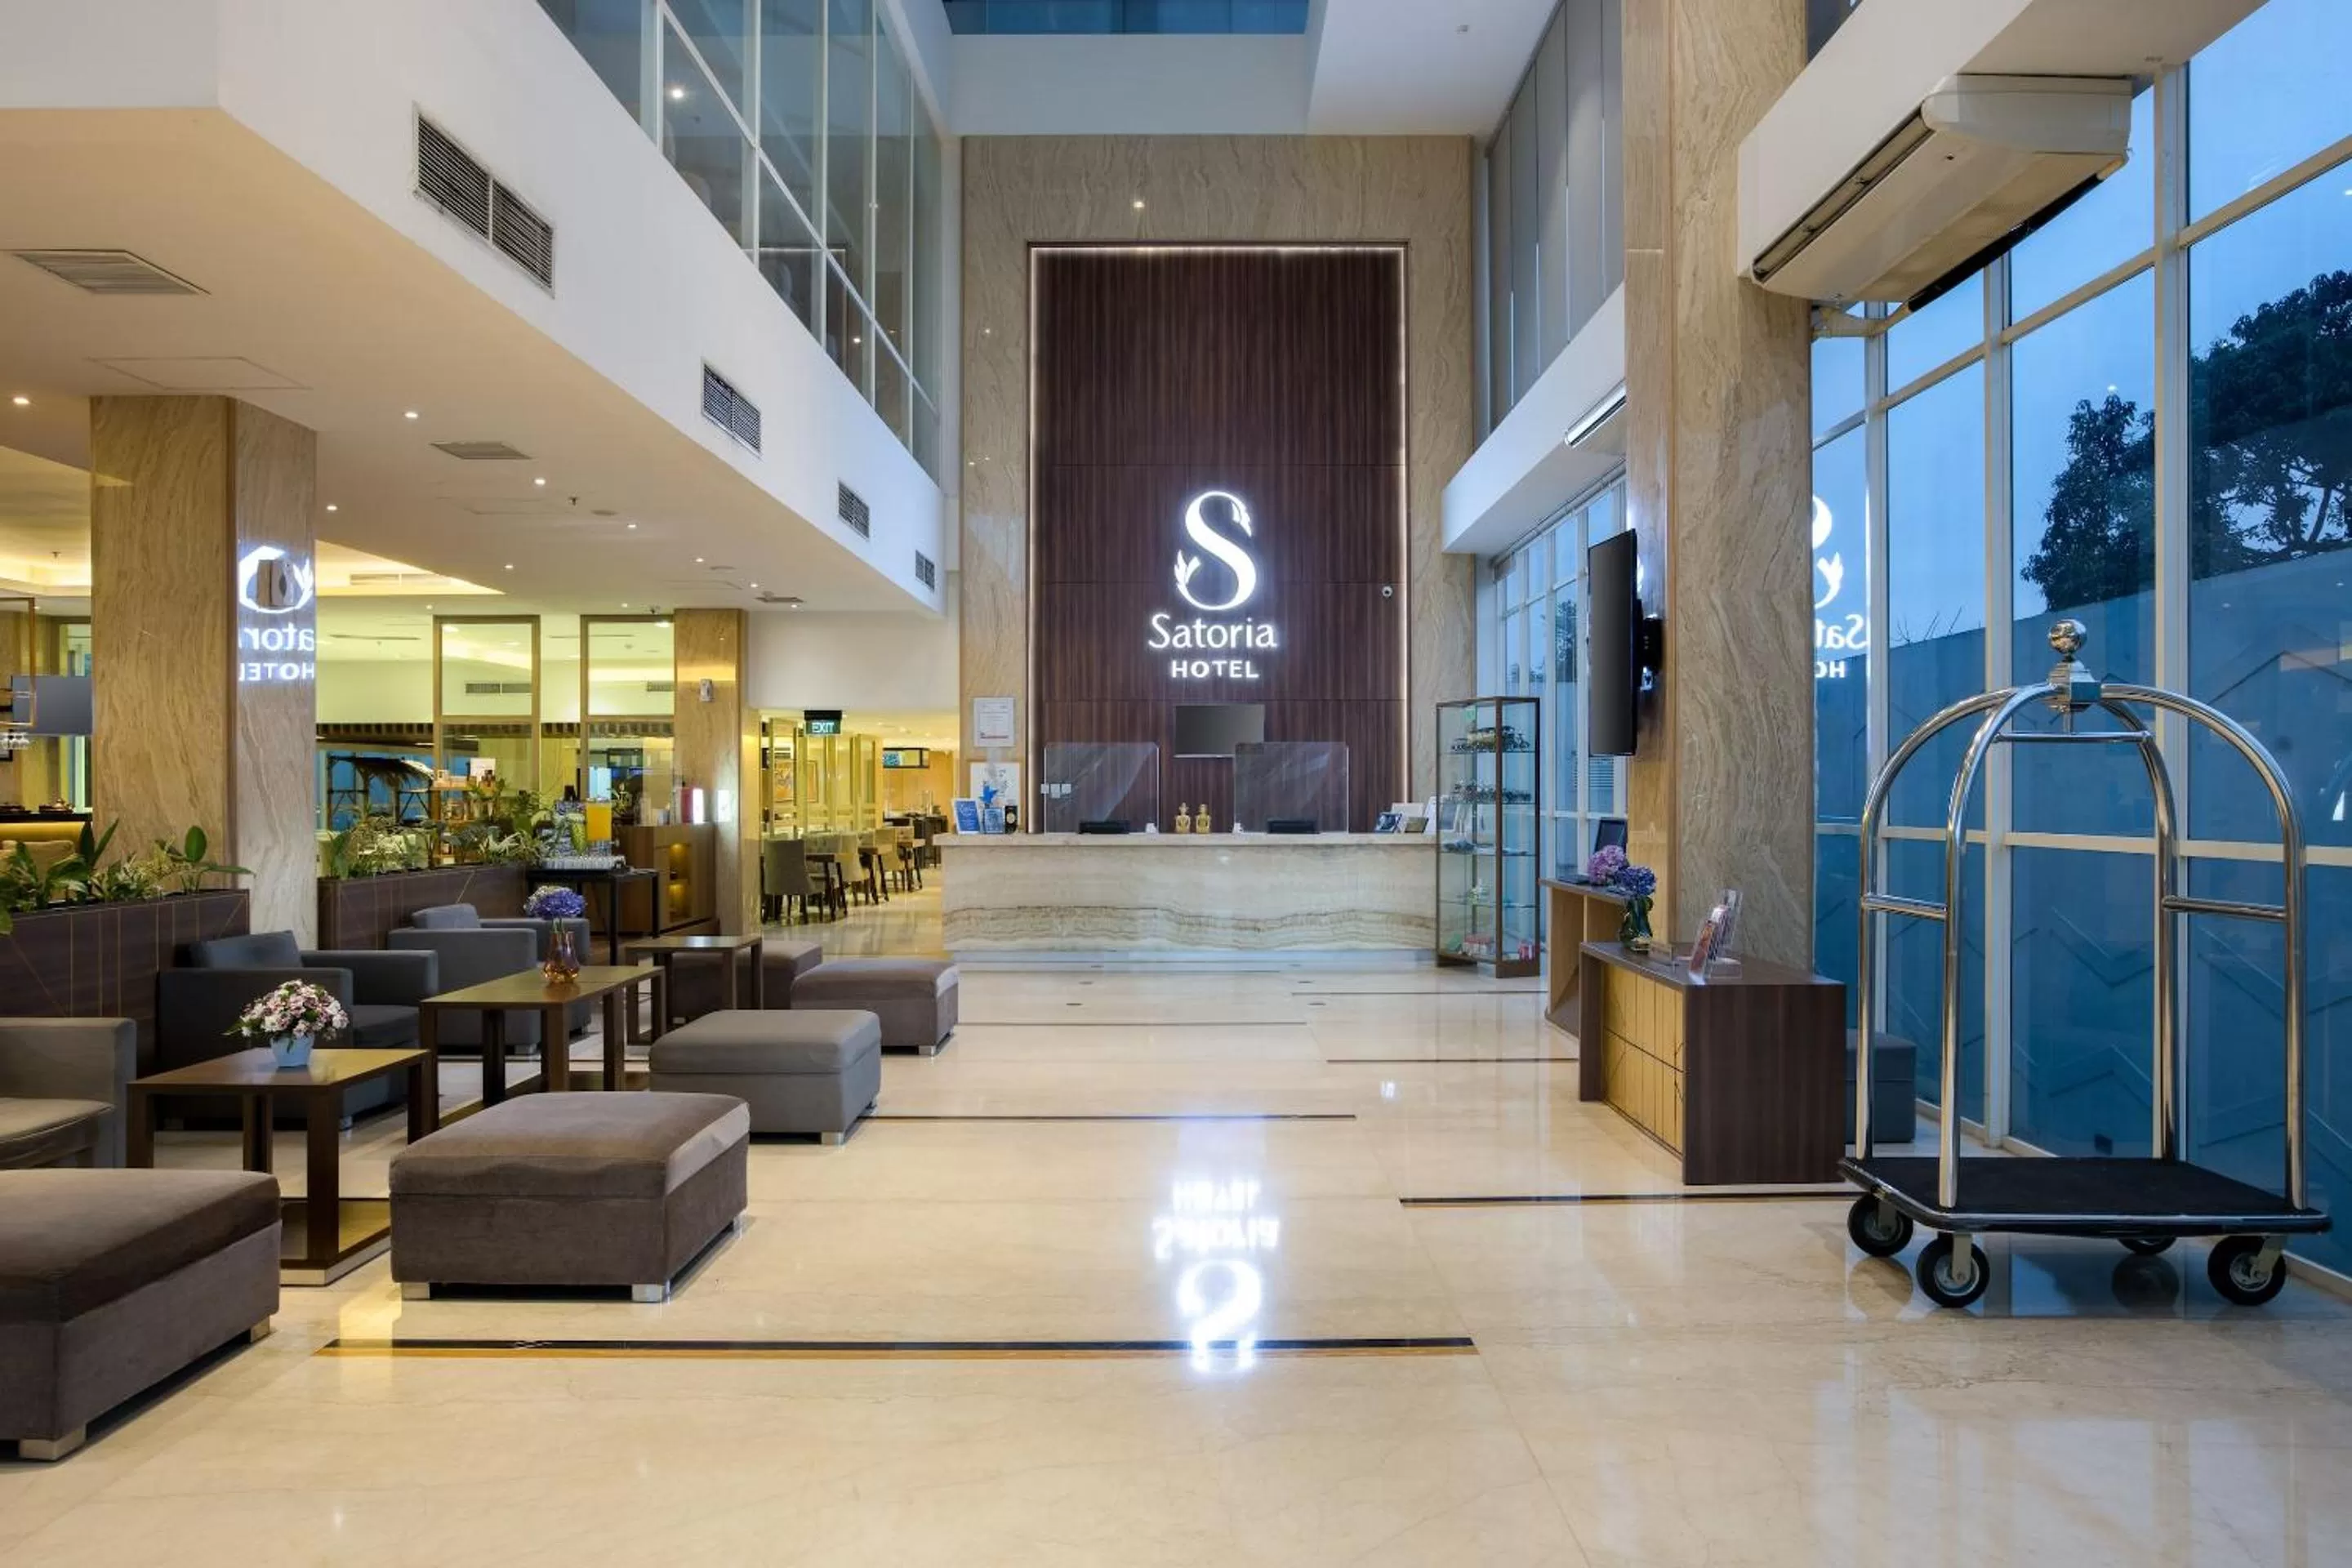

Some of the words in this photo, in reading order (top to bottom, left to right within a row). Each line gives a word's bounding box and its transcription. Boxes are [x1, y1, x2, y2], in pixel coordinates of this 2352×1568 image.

[1147, 612, 1279, 649] Satoria
[1170, 660, 1260, 679] HOTEL
[812, 722, 835, 733] EXIT
